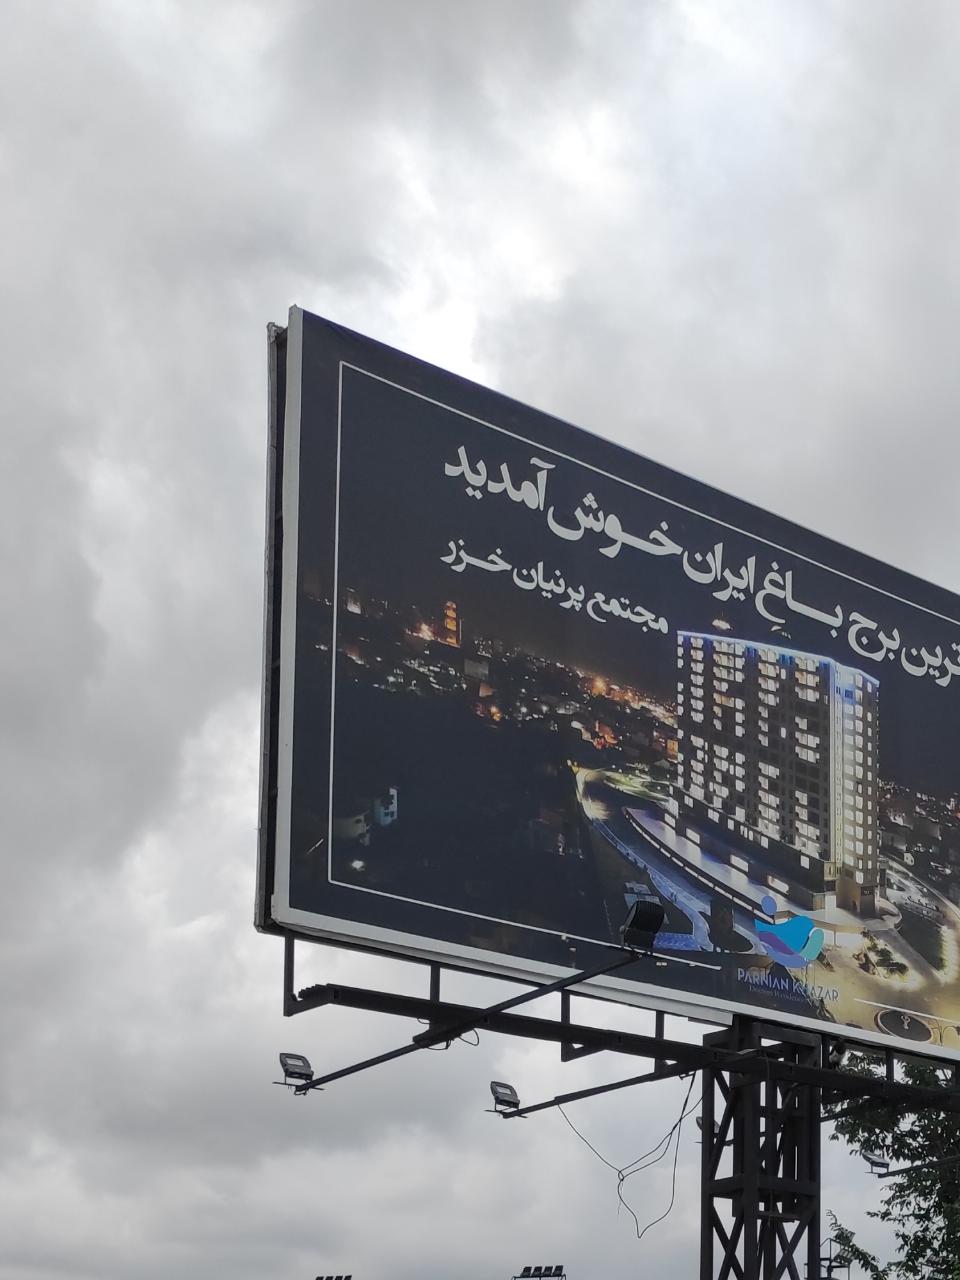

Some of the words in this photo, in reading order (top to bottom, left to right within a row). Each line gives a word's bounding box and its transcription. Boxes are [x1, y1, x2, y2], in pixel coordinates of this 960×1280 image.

[444, 445, 556, 511] آمدید
[547, 492, 683, 559] خوش
[439, 538, 513, 573] خزر
[682, 542, 756, 602] ایران
[512, 561, 585, 612] پرنیان
[586, 591, 669, 635] مجتمع
[847, 611, 900, 662] برج
[737, 967, 789, 991] PARNIAN
[792, 980, 839, 1001] KAZAR
